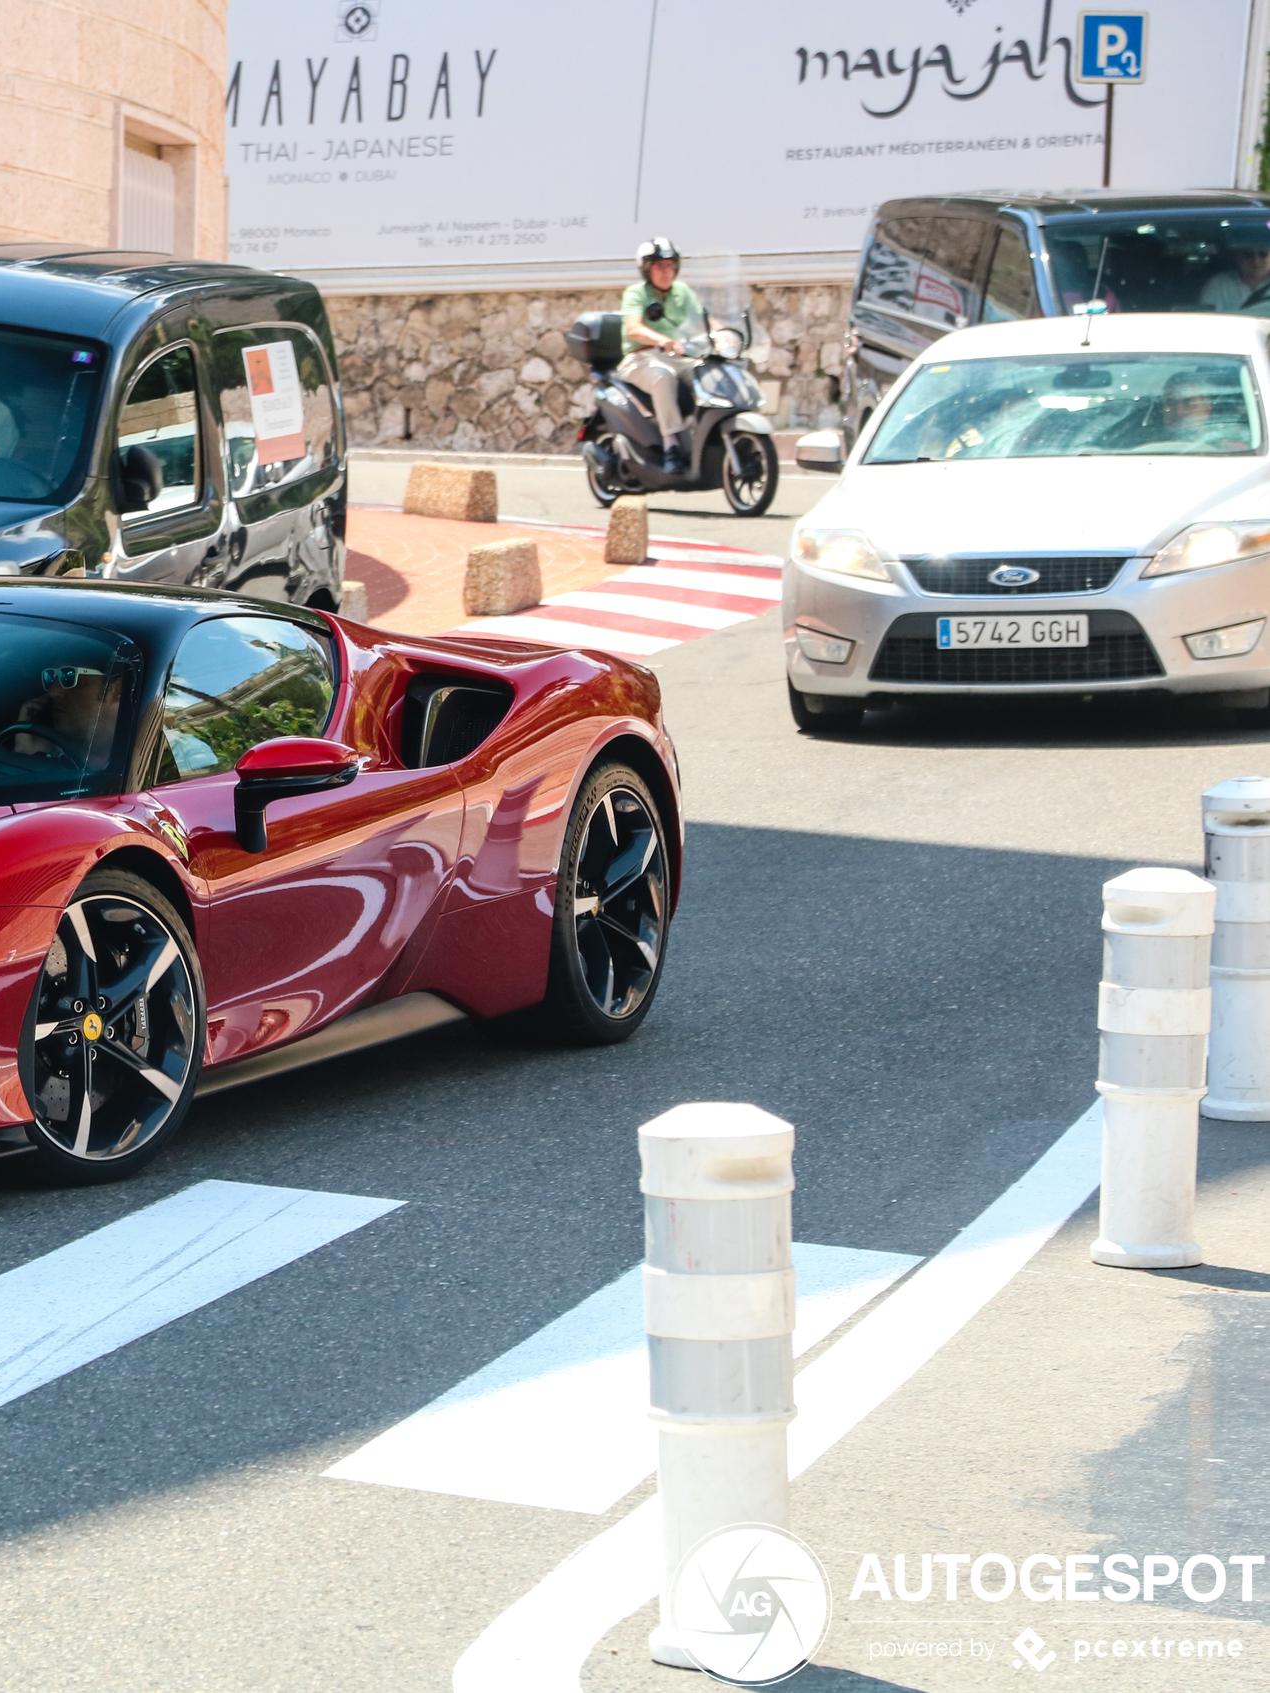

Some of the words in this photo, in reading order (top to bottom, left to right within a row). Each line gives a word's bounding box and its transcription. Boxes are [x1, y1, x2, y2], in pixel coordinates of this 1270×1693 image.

[1097, 24, 1128, 68] P
[239, 142, 298, 162] THAI
[322, 135, 455, 161] JAPANESE
[786, 145, 884, 161] RESTAURANT
[889, 136, 1017, 156] MÉDITERRANÉEN
[1021, 138, 1031, 149] &
[1036, 133, 1105, 149] ORIENTA
[268, 172, 331, 185] MONACO
[355, 170, 397, 182] DUBAI
[284, 227, 330, 238] Monaco
[513, 218, 548, 230] Dubai
[560, 216, 588, 228] UAE
[1001, 572, 1024, 582] Ford
[956, 621, 1020, 644] 5742
[1032, 620, 1080, 643] GGH
[570, 805, 589, 865] MICHELIN
